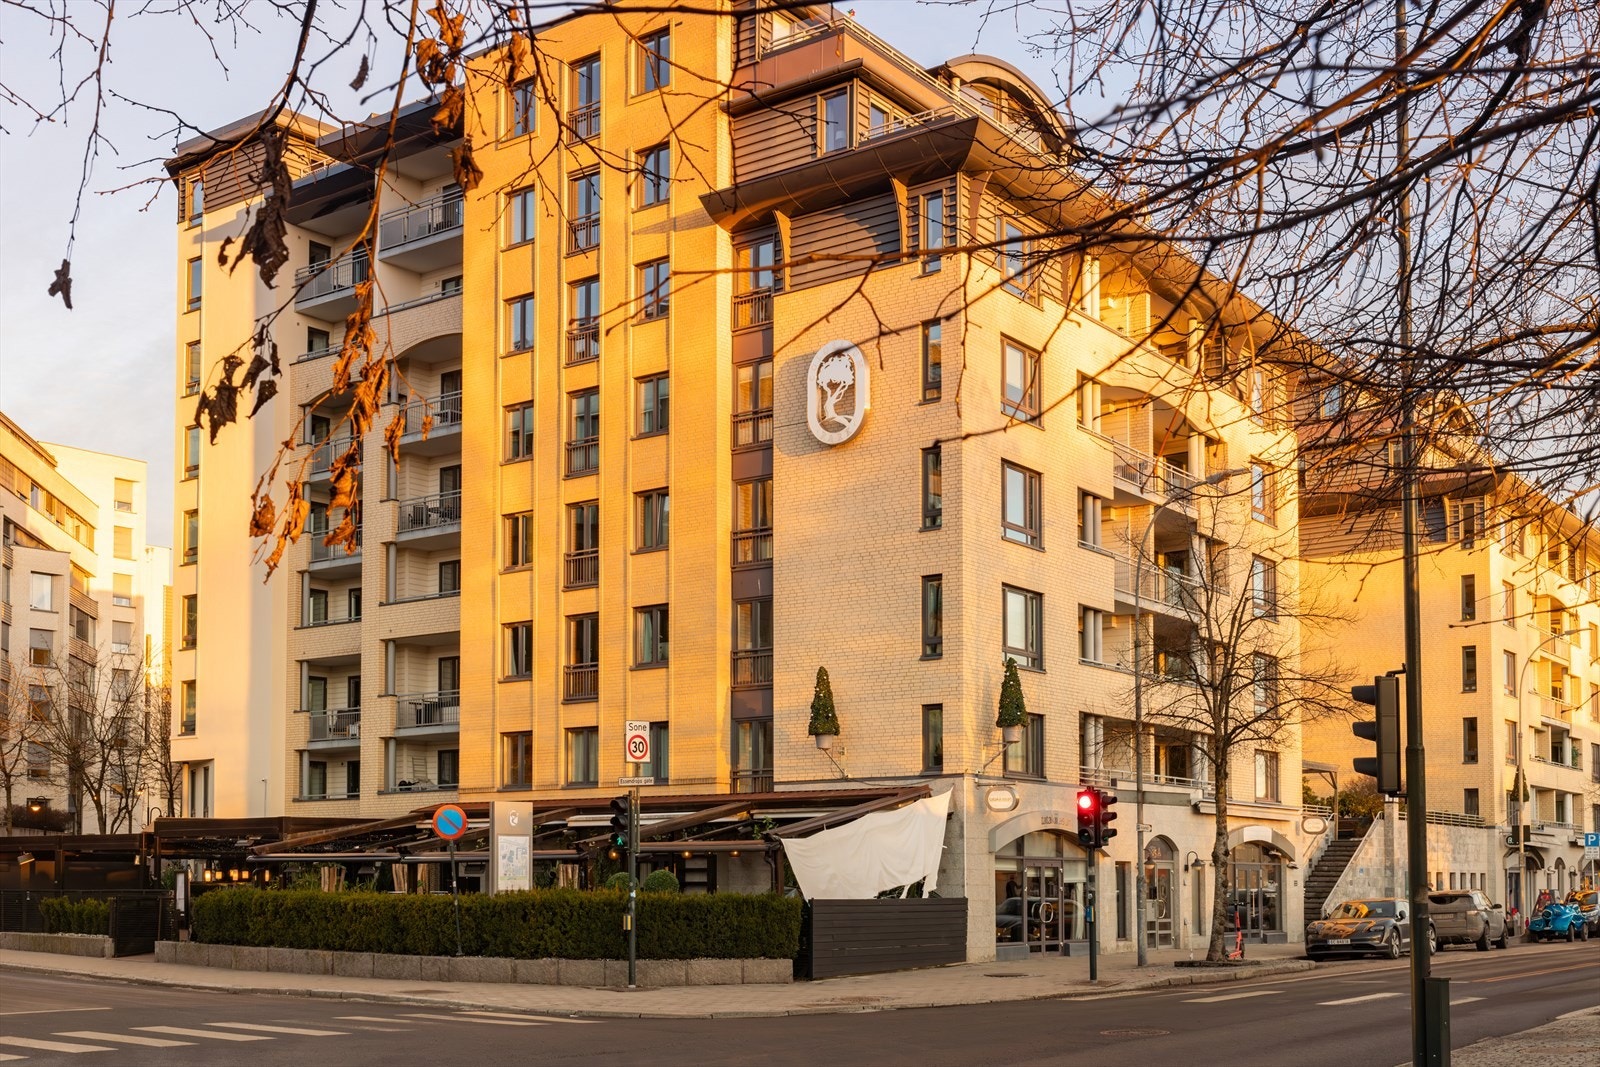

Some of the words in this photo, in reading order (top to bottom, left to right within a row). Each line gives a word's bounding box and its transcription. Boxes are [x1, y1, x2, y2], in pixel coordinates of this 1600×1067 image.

[628, 722, 647, 732] Sone
[632, 741, 644, 753] 30
[1588, 834, 1596, 845] P
